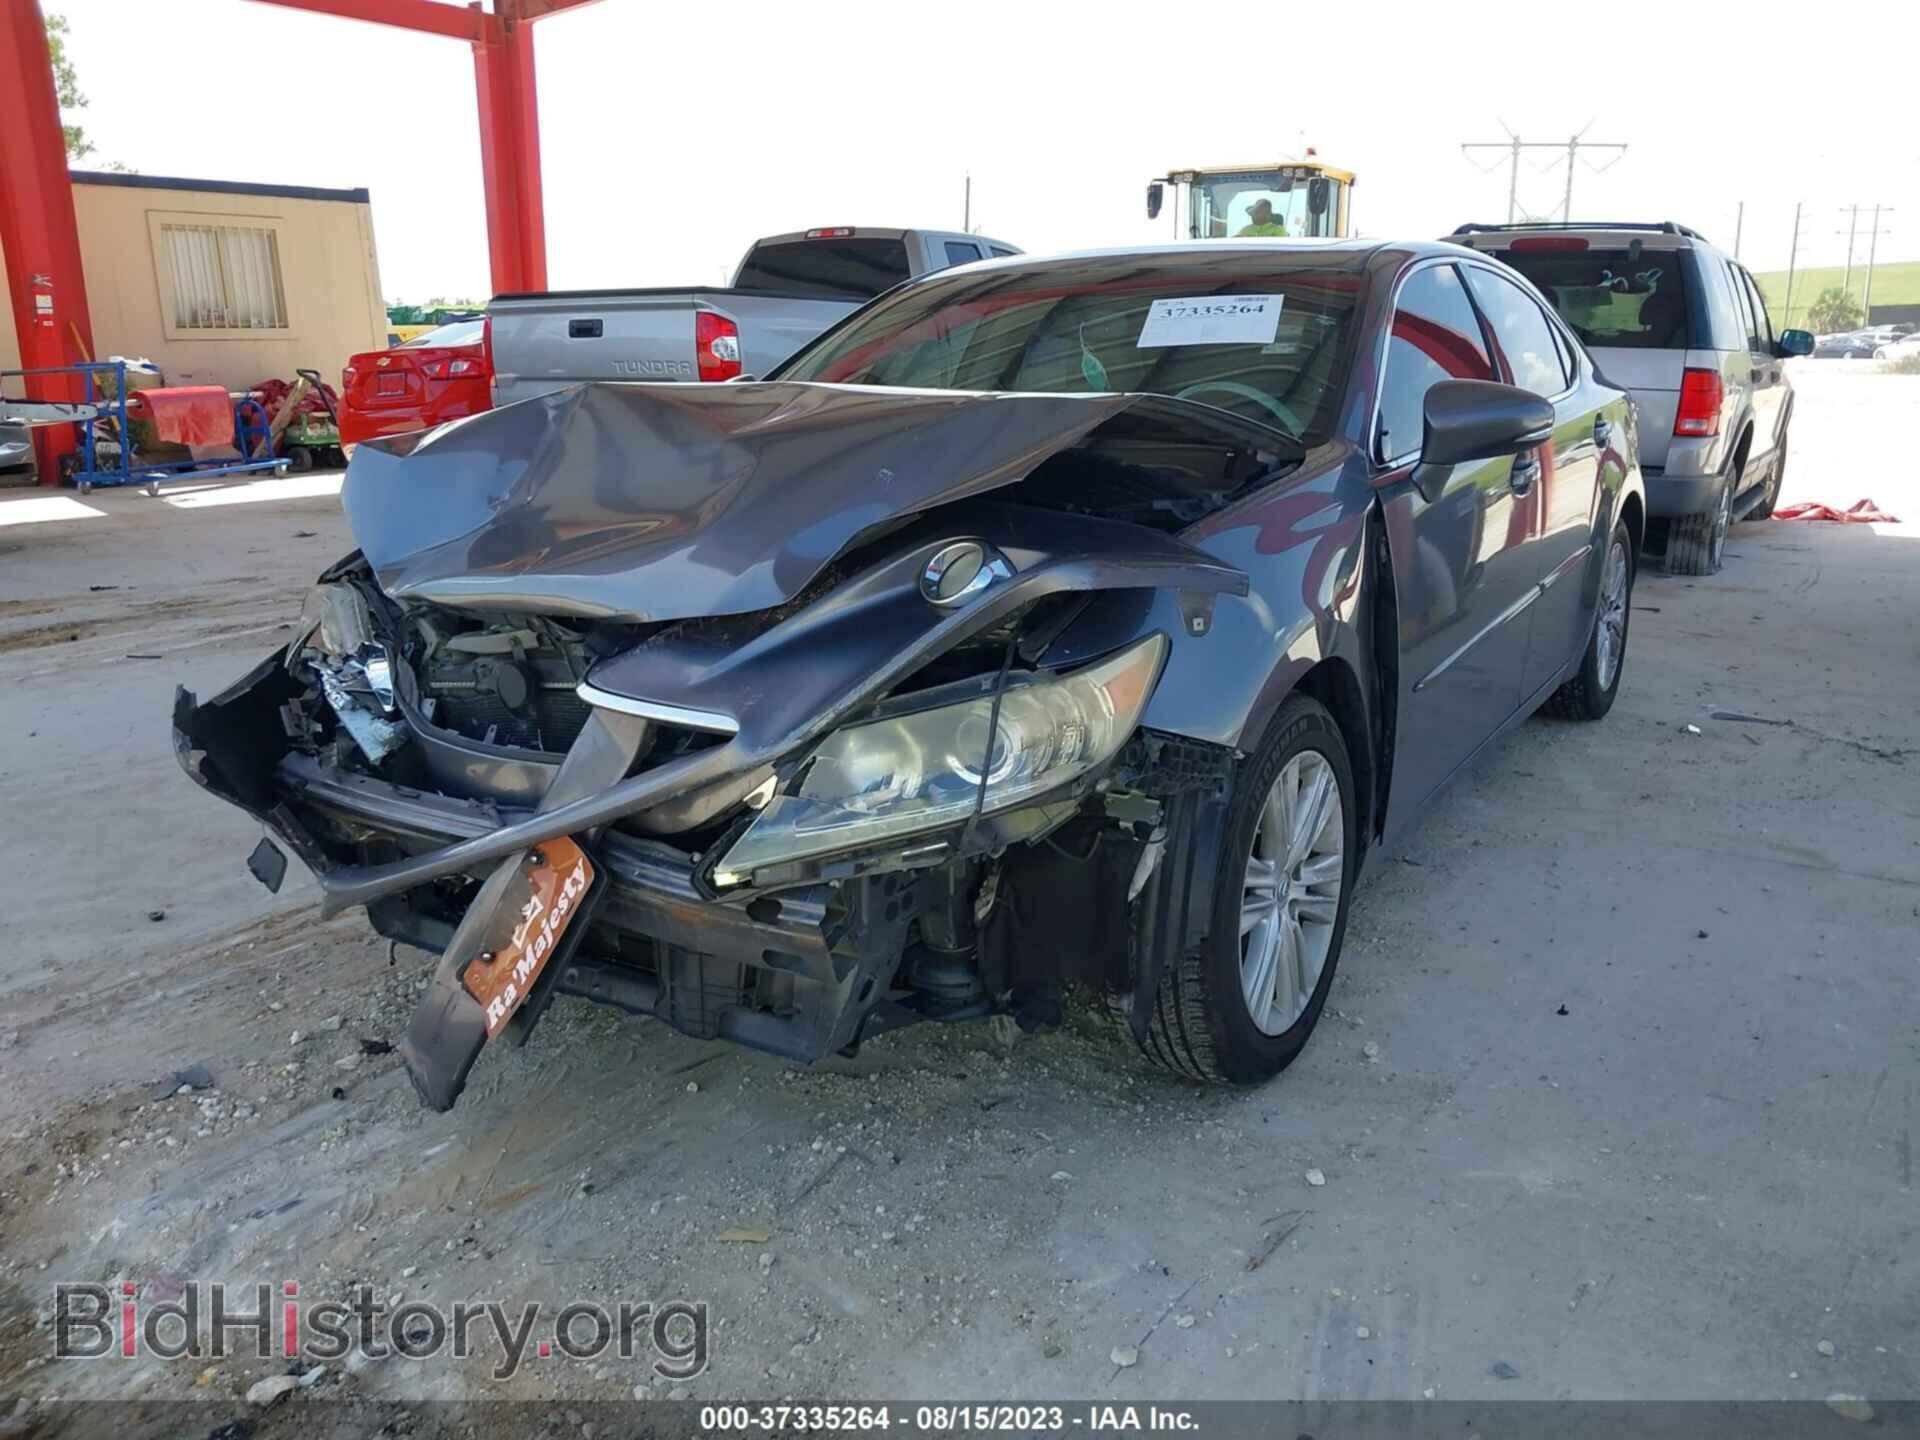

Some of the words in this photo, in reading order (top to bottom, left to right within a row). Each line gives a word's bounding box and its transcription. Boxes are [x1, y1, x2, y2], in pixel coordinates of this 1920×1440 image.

[1160, 304, 1265, 318] 37335264
[609, 359, 692, 376] TUNDRA
[486, 983, 518, 1029] Ra
[512, 857, 586, 985] Majesty
